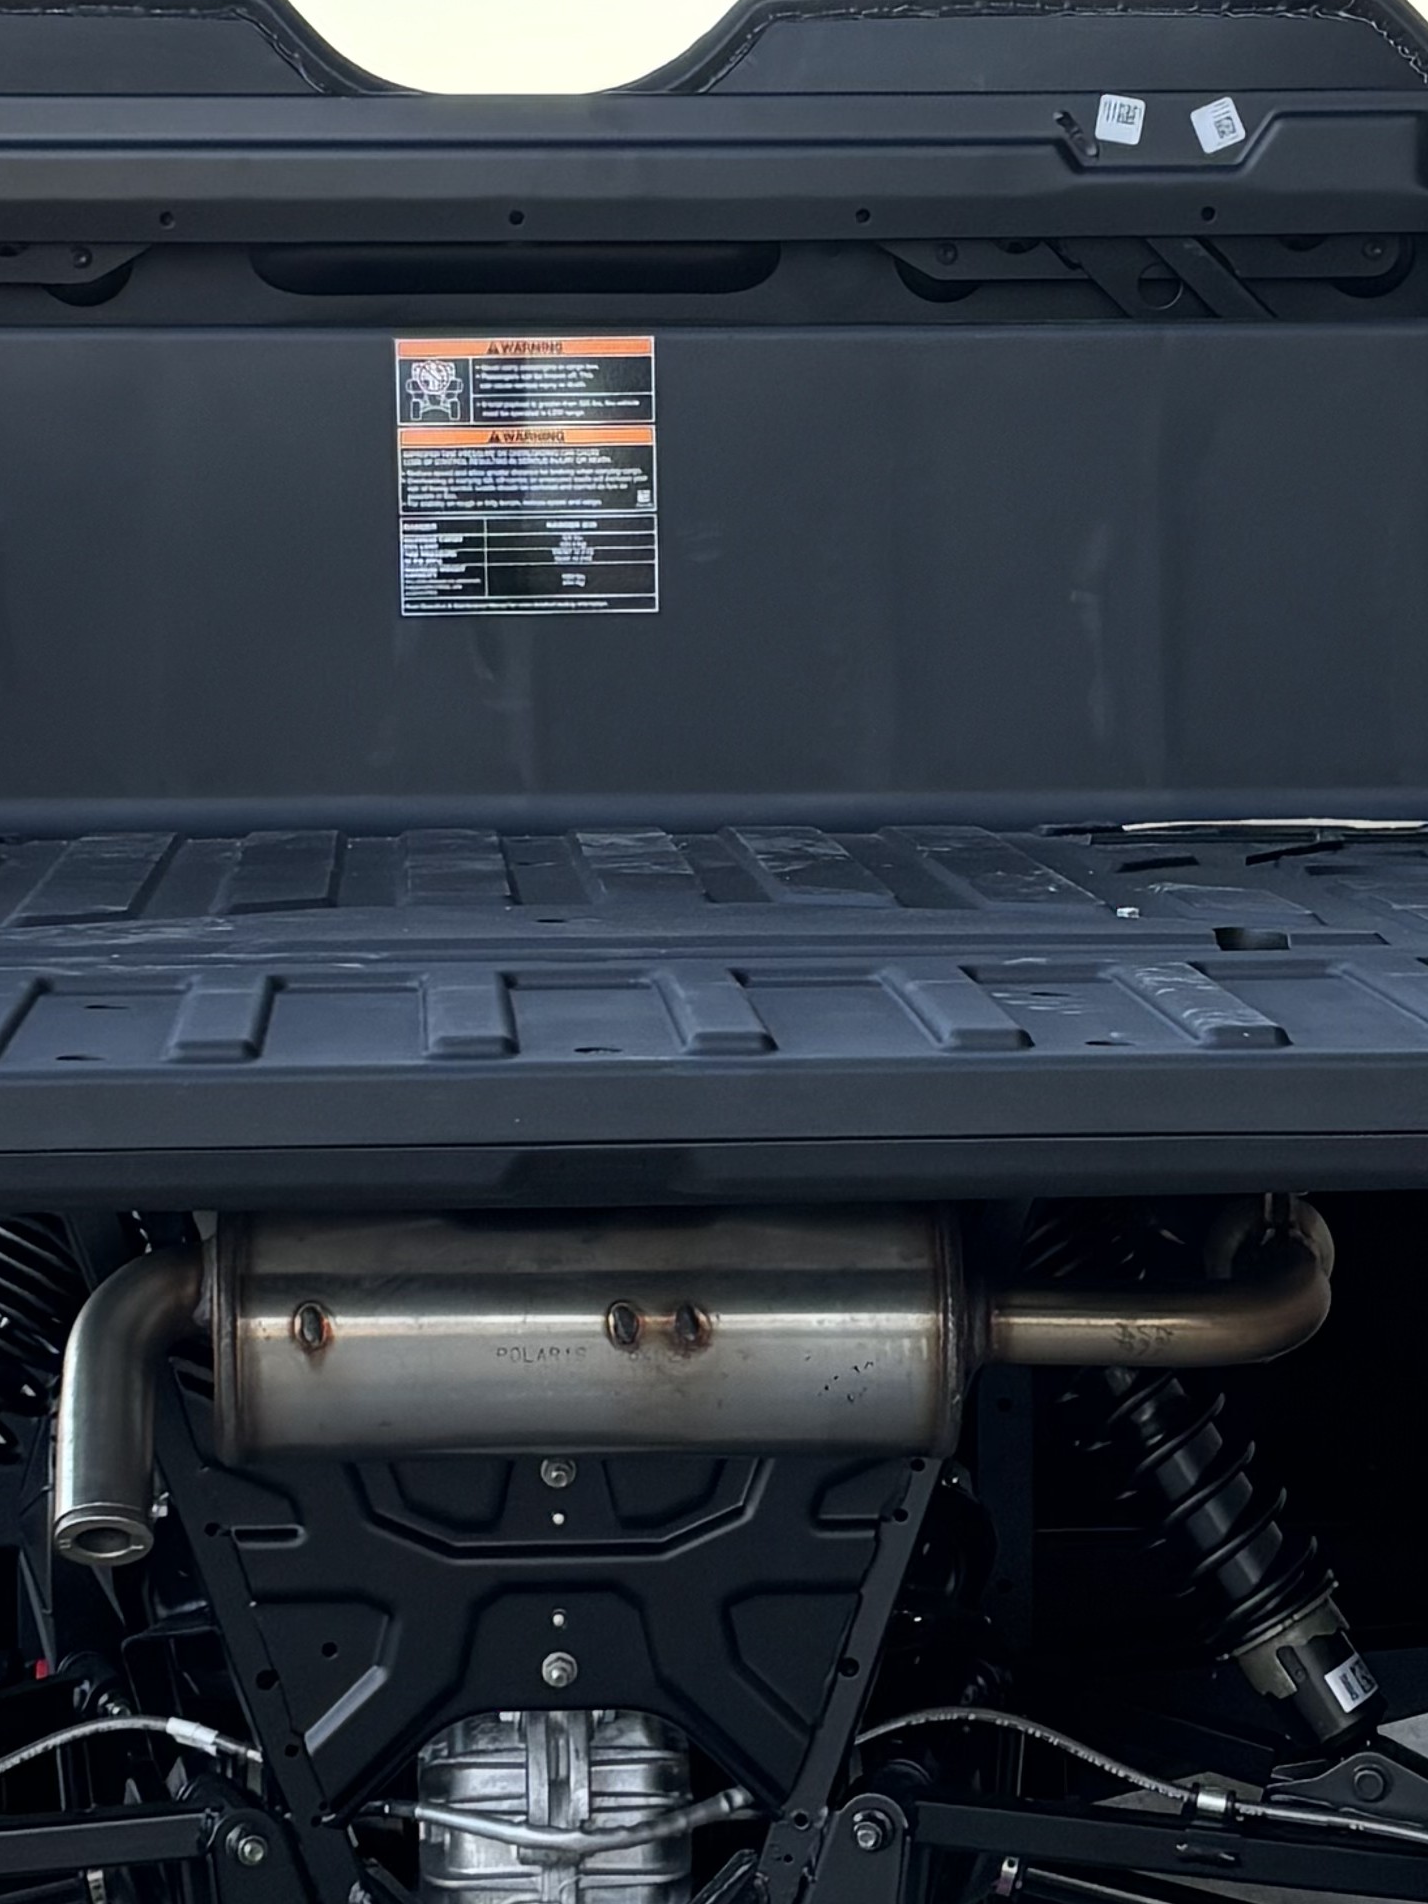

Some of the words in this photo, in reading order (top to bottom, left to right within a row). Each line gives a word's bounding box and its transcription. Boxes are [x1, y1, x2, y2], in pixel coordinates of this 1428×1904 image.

[501, 341, 563, 354] WARNING
[503, 430, 565, 443] WARNING
[495, 1346, 587, 1364] POLARIS
